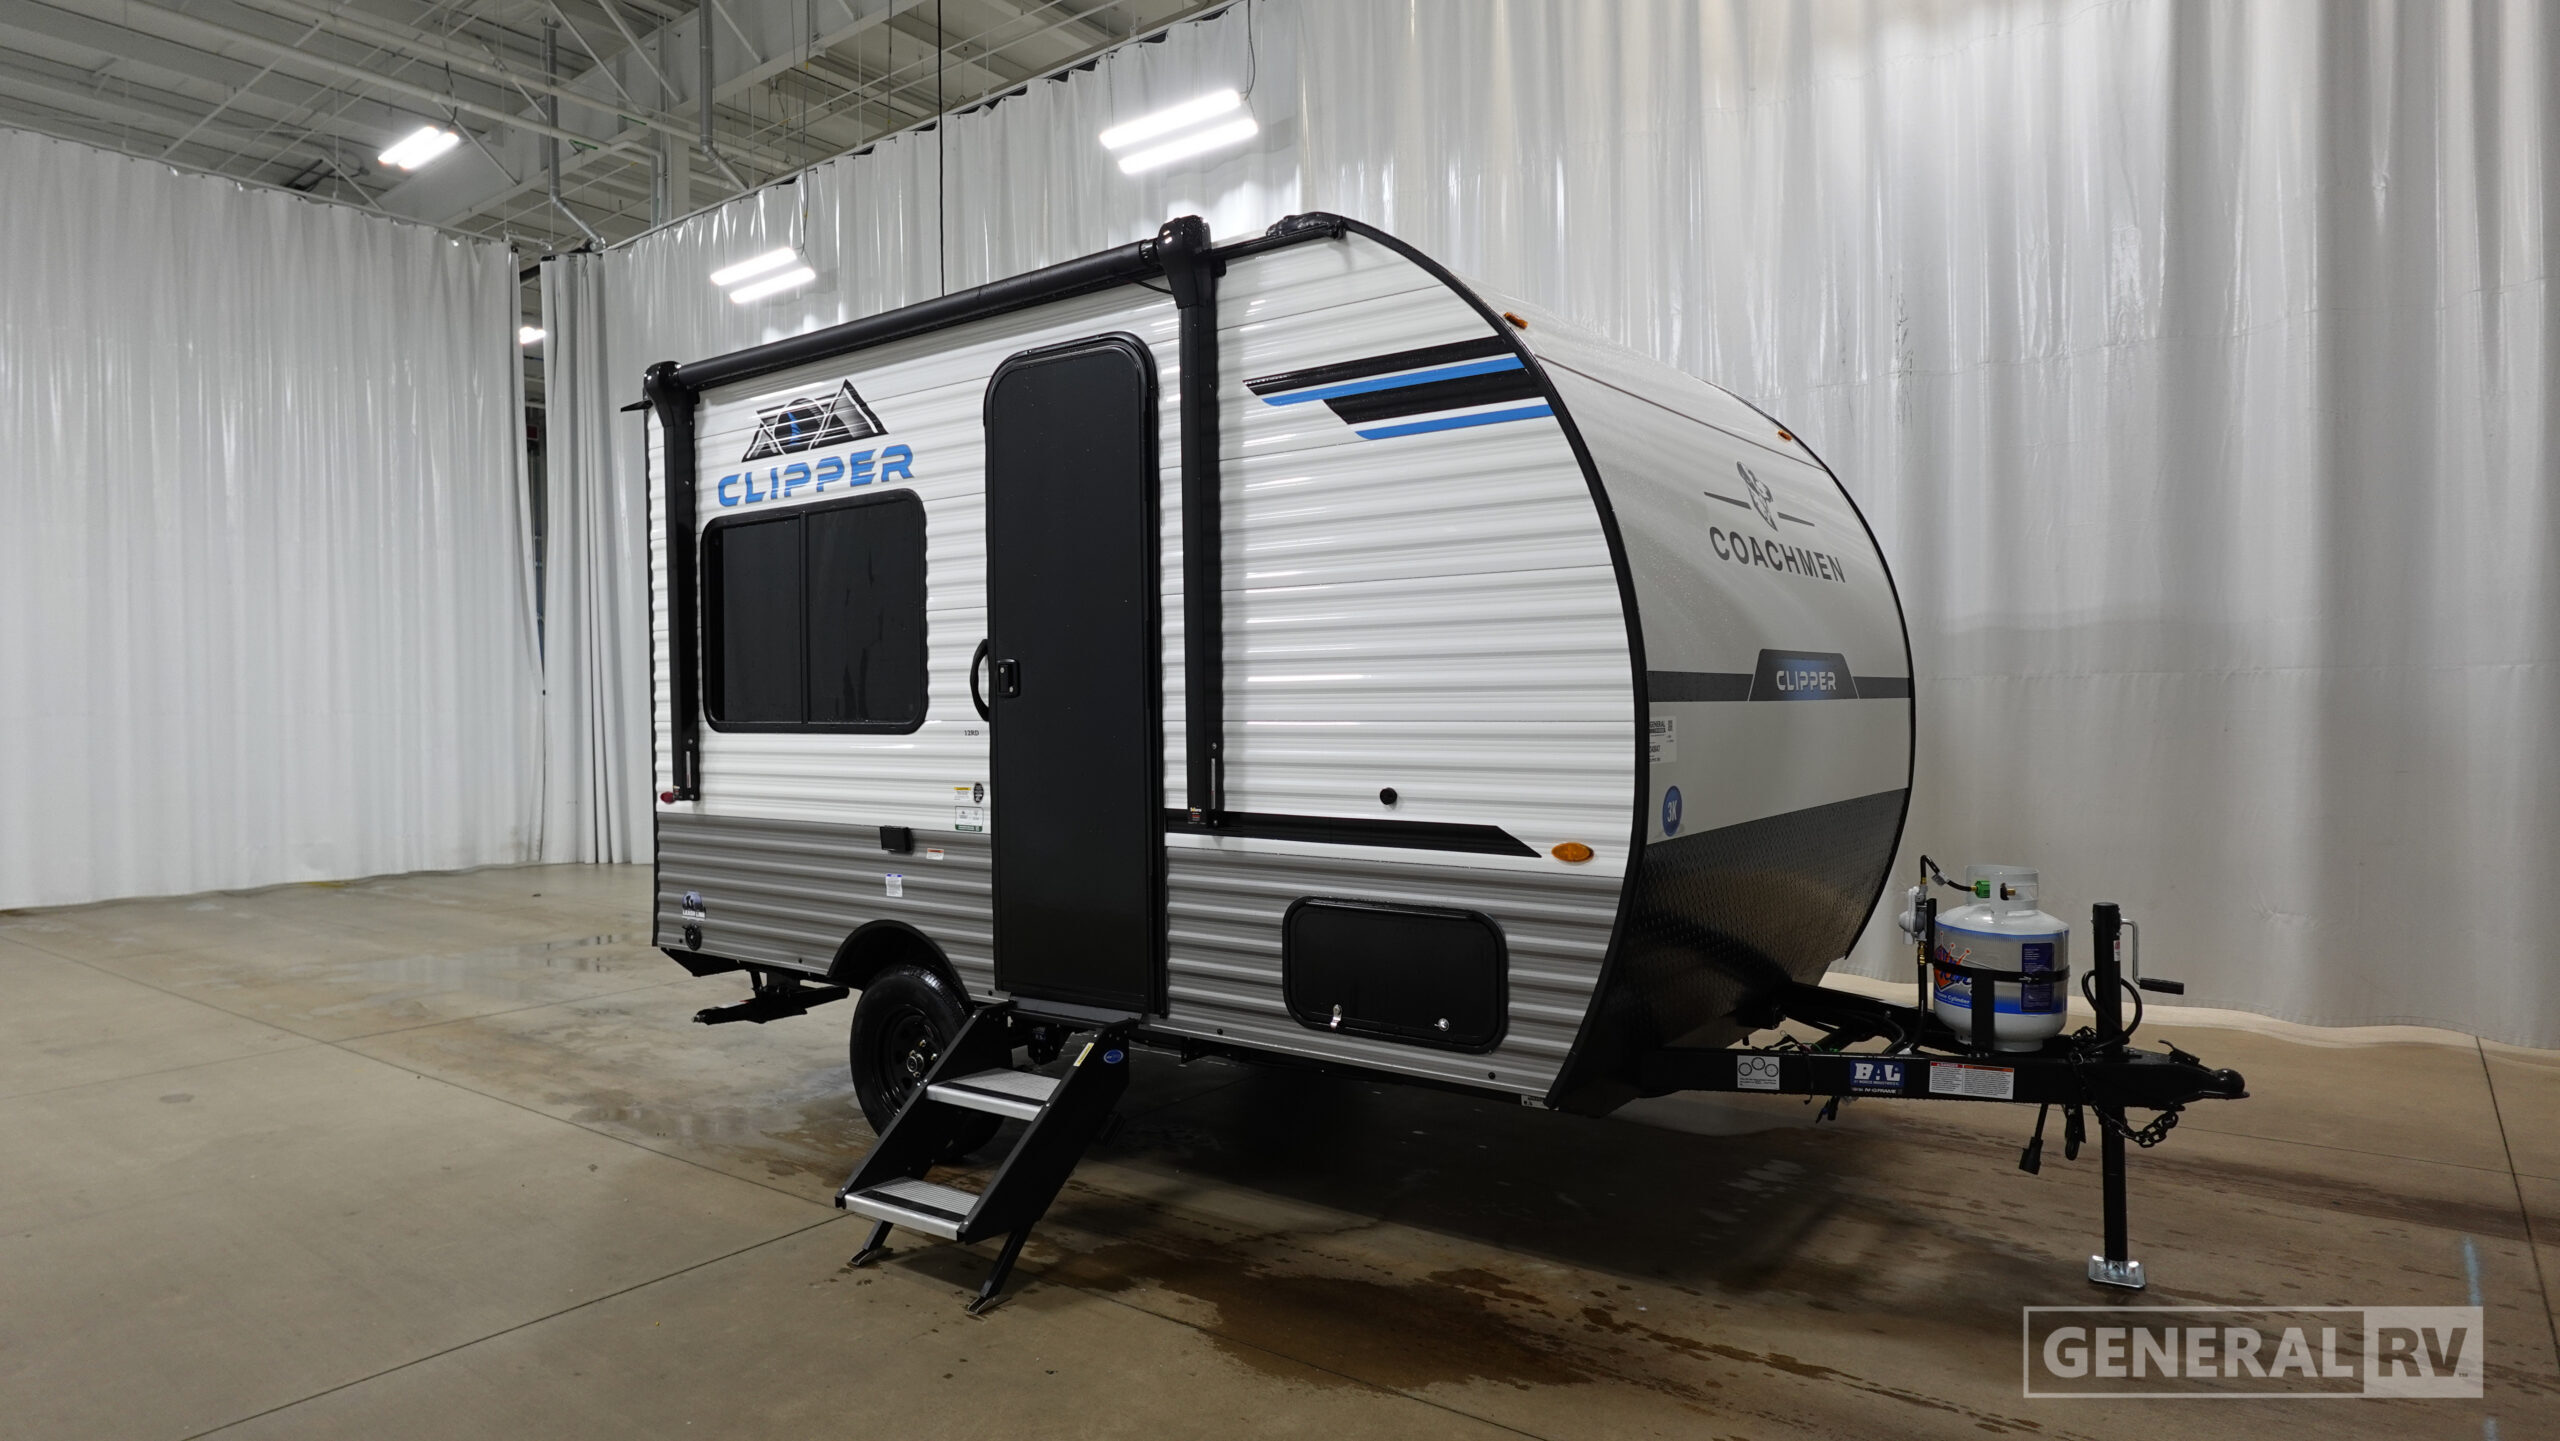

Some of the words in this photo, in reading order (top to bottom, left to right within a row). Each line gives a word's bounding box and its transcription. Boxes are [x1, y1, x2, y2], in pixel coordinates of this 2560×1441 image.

[718, 443, 914, 507] CLIPPER
[1709, 526, 1846, 583] COACHMEN
[1776, 670, 1836, 691] CLIPPER
[1667, 800, 1678, 822] 3K
[1854, 1063, 1901, 1081] BAL
